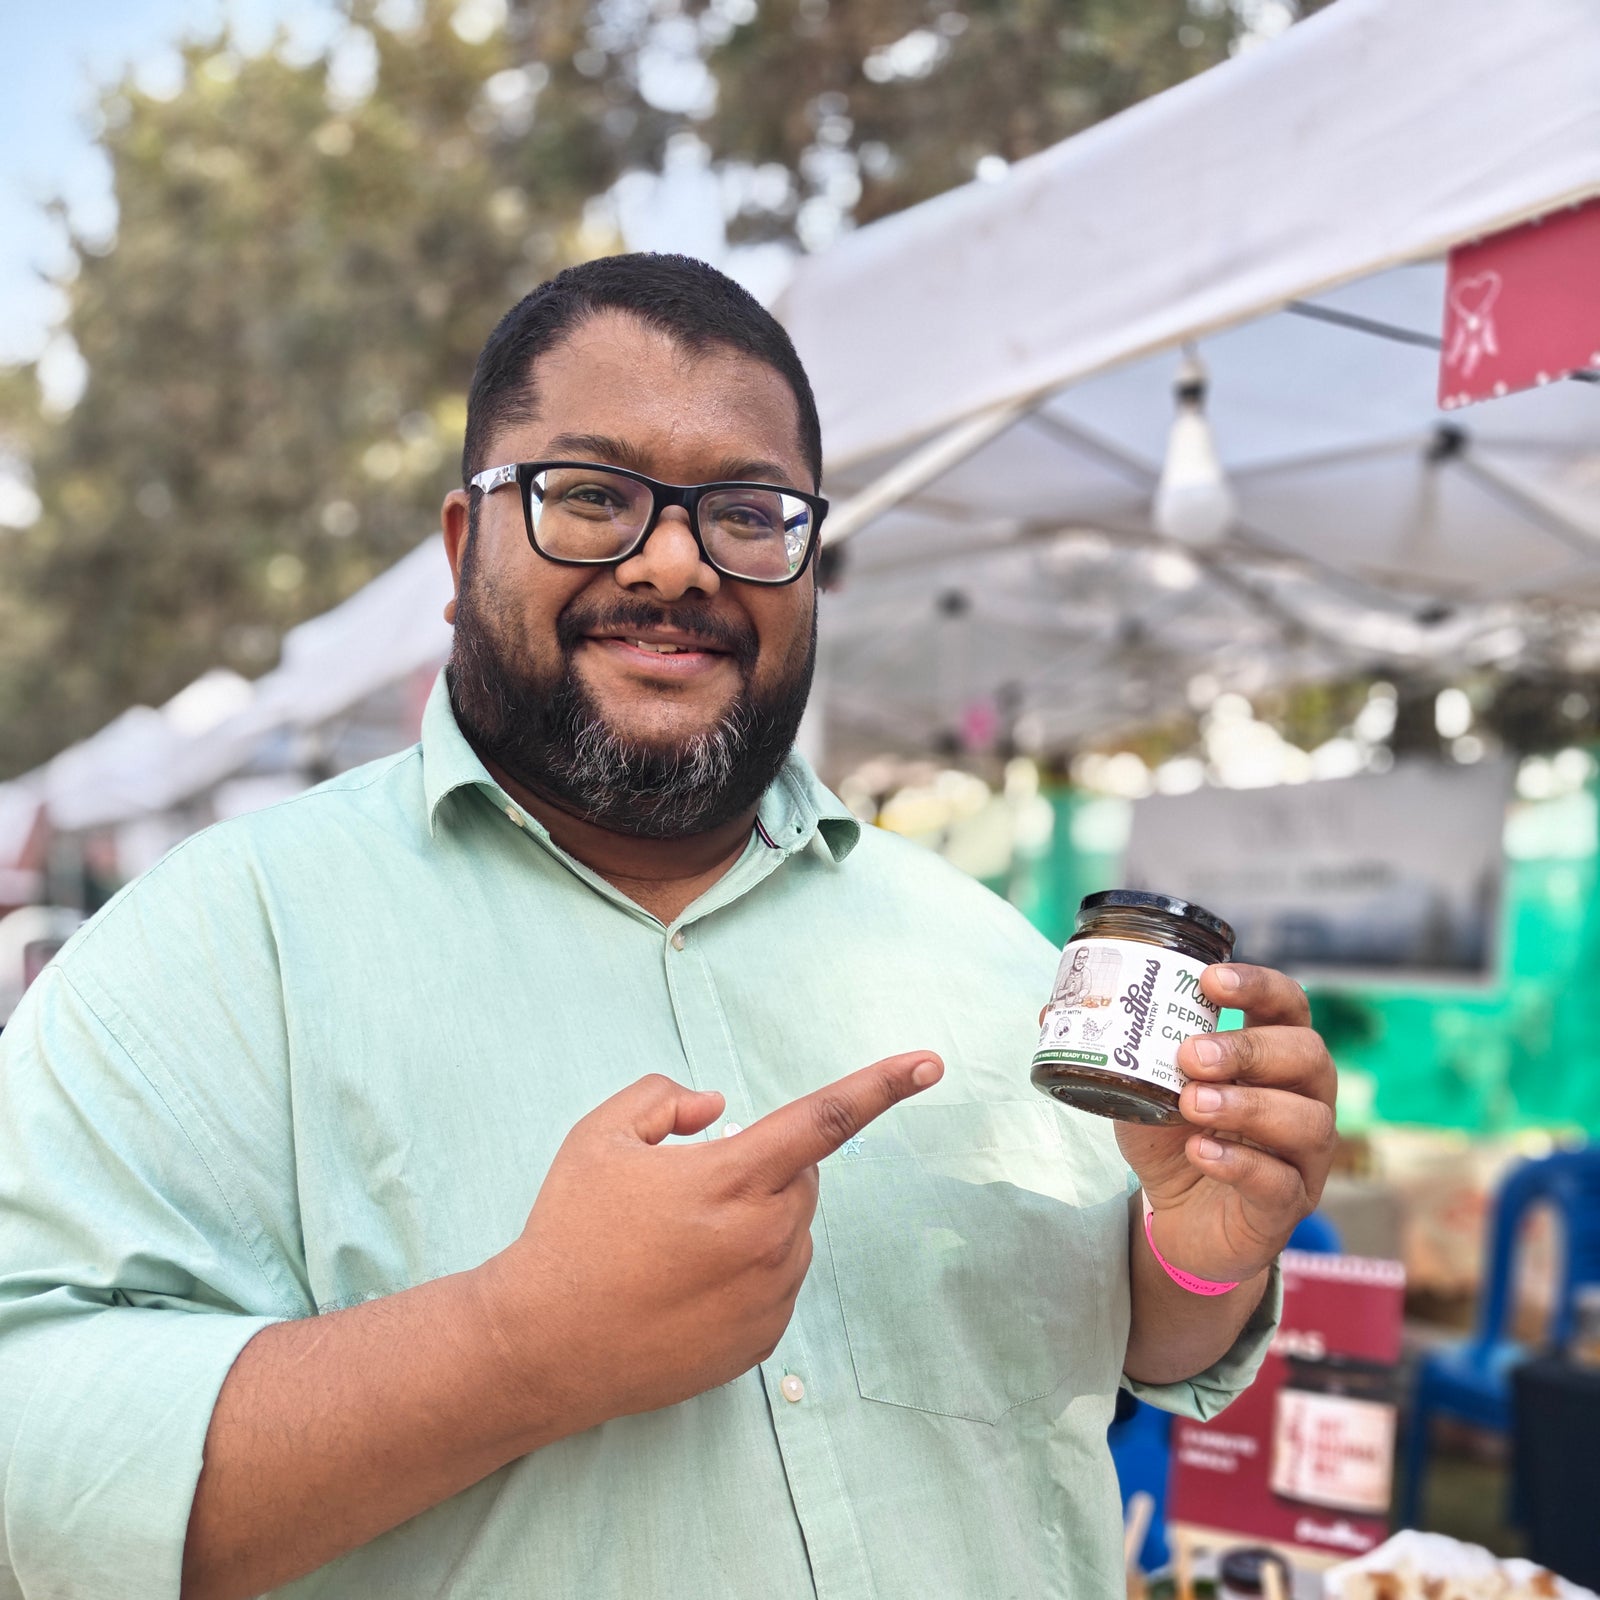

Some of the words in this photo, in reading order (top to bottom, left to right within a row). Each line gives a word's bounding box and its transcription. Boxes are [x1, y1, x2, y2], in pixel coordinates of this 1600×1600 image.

[1113, 959, 1161, 1071] Grindhaus
[1145, 1001, 1160, 1036] PANTRY
[1090, 1054, 1104, 1062] EAT
[1151, 1068, 1173, 1082] HOT
